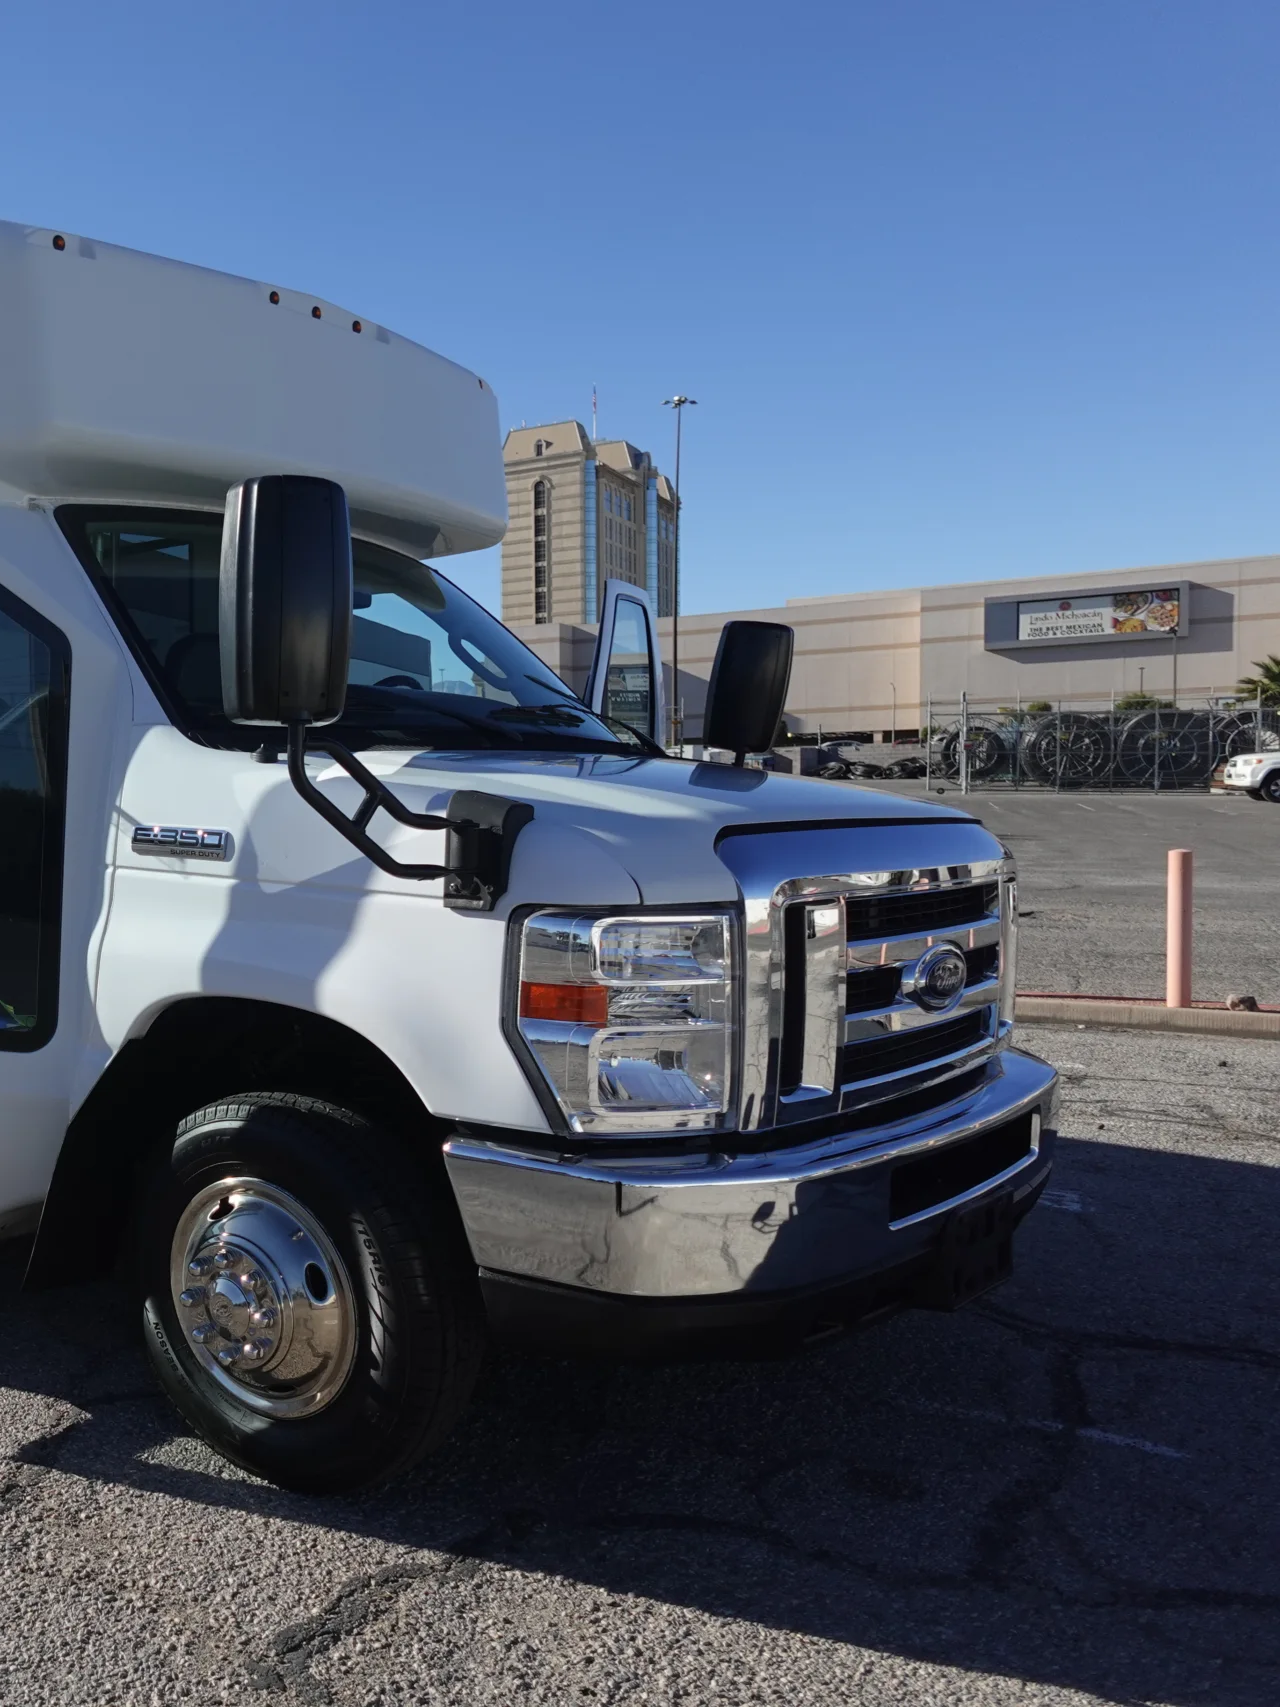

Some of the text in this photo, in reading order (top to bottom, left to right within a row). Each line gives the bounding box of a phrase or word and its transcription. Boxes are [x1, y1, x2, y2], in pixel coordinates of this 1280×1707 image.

[1029, 614, 1053, 625] Lindo
[1060, 628, 1105, 636] COCKTAILS
[170, 848, 197, 857] SUPER
[152, 1321, 179, 1373] SEASON
